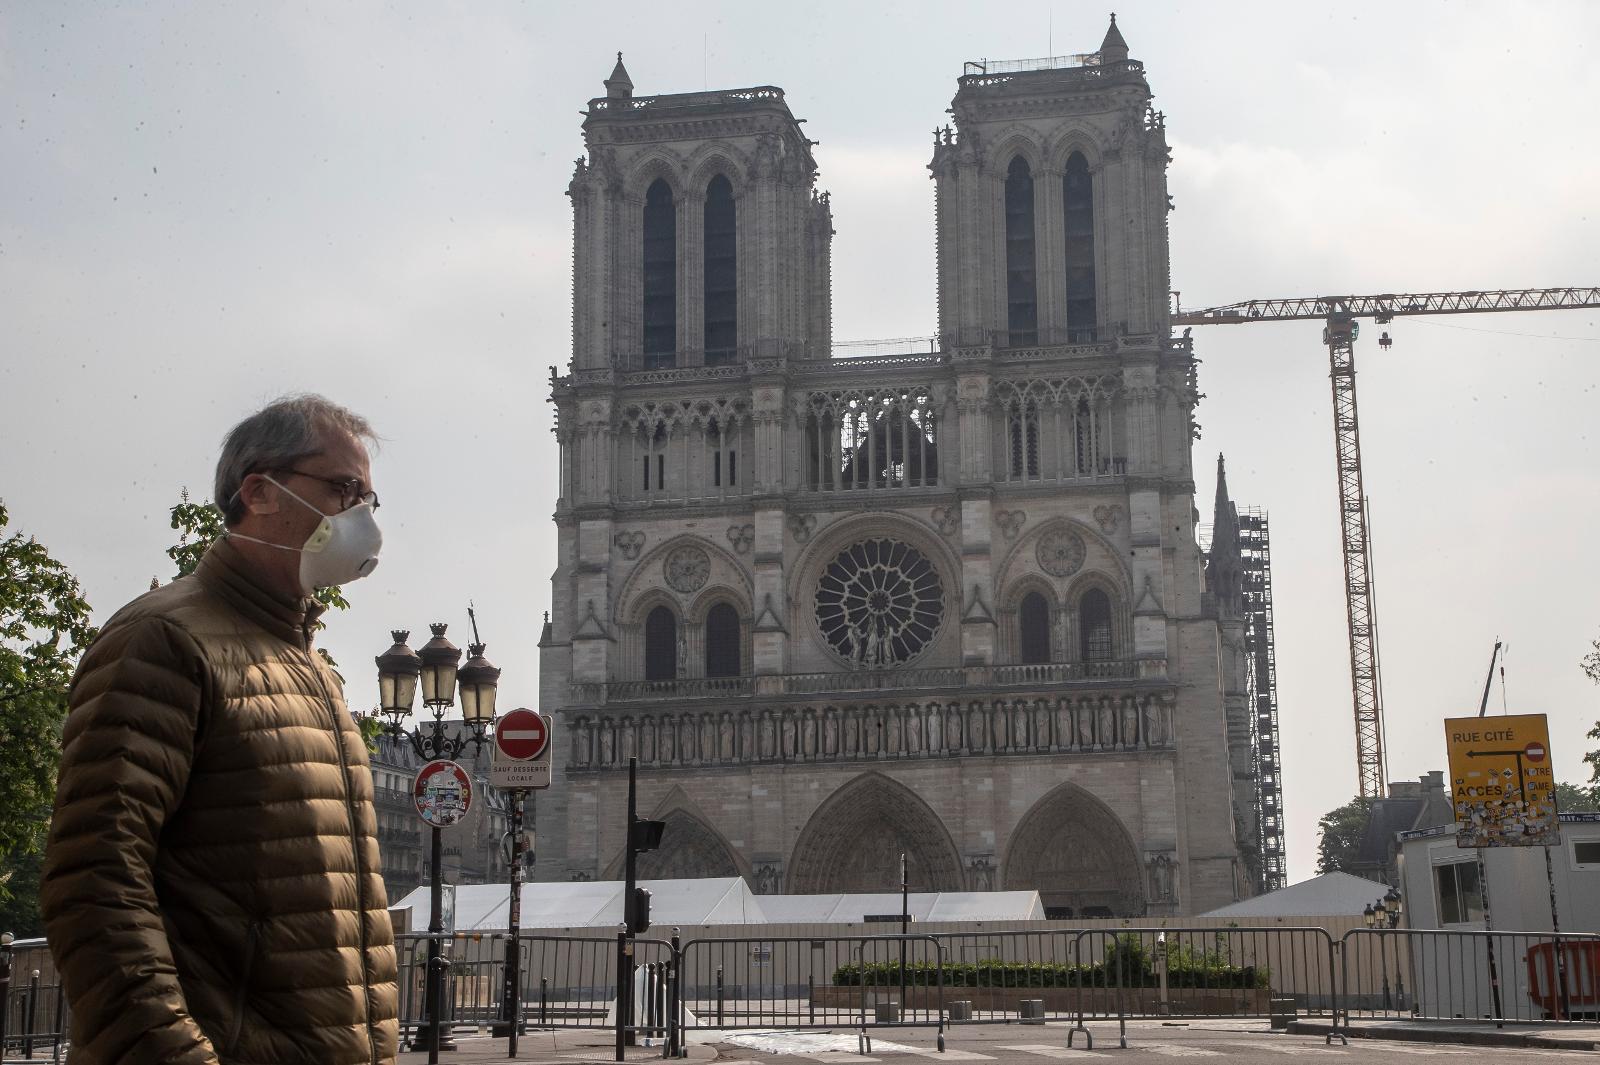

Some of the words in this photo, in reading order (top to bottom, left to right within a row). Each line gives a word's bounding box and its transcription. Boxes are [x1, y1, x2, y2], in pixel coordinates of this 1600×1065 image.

[1453, 732, 1480, 743] RUE
[1484, 728, 1514, 741] CITÉ
[1523, 767, 1550, 776] NTRE
[1457, 785, 1502, 796] ACCES
